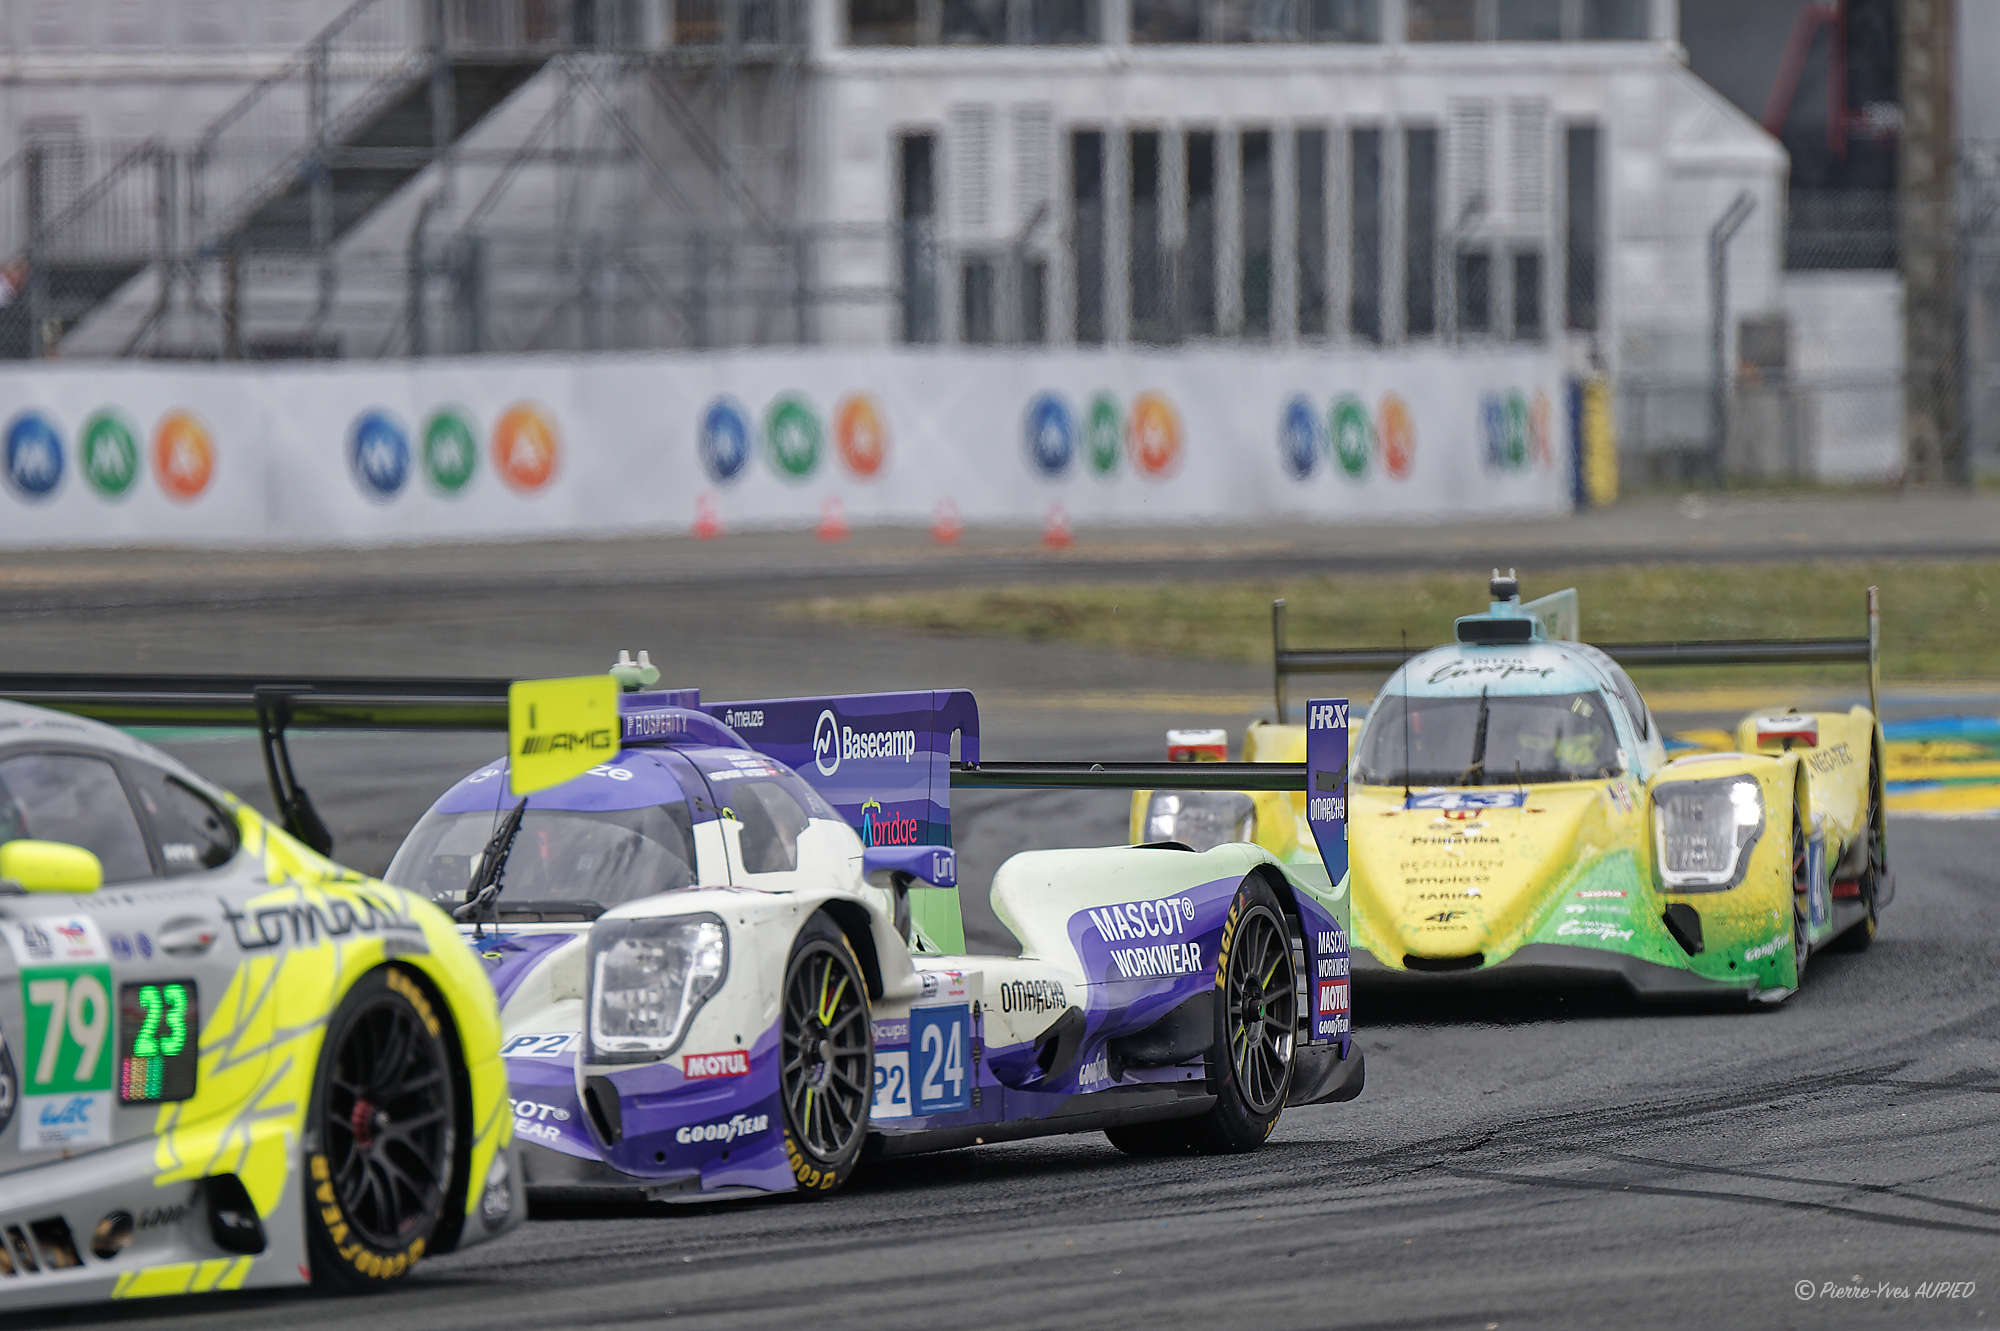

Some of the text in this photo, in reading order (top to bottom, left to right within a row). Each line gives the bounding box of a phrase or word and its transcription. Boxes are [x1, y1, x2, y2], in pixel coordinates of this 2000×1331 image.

[627, 713, 688, 736] PROSPERITY
[734, 710, 765, 728] meuze
[1310, 704, 1349, 730] HRX
[548, 729, 612, 752] AMG
[842, 726, 916, 764] Basecamp
[862, 811, 917, 847] Abridge
[1089, 896, 1195, 943] MASCOT®
[1110, 942, 1203, 978] WORKWEAR
[1215, 904, 1240, 991] EAGLE
[1320, 986, 1349, 1011] MOTUL
[28, 974, 109, 1085] 79
[133, 984, 187, 1057] 23
[501, 1035, 569, 1053] P2
[920, 1021, 964, 1101] 24
[687, 1053, 747, 1077] MOTUL
[872, 1065, 907, 1106] P2
[675, 1114, 769, 1144] GOODYEAR
